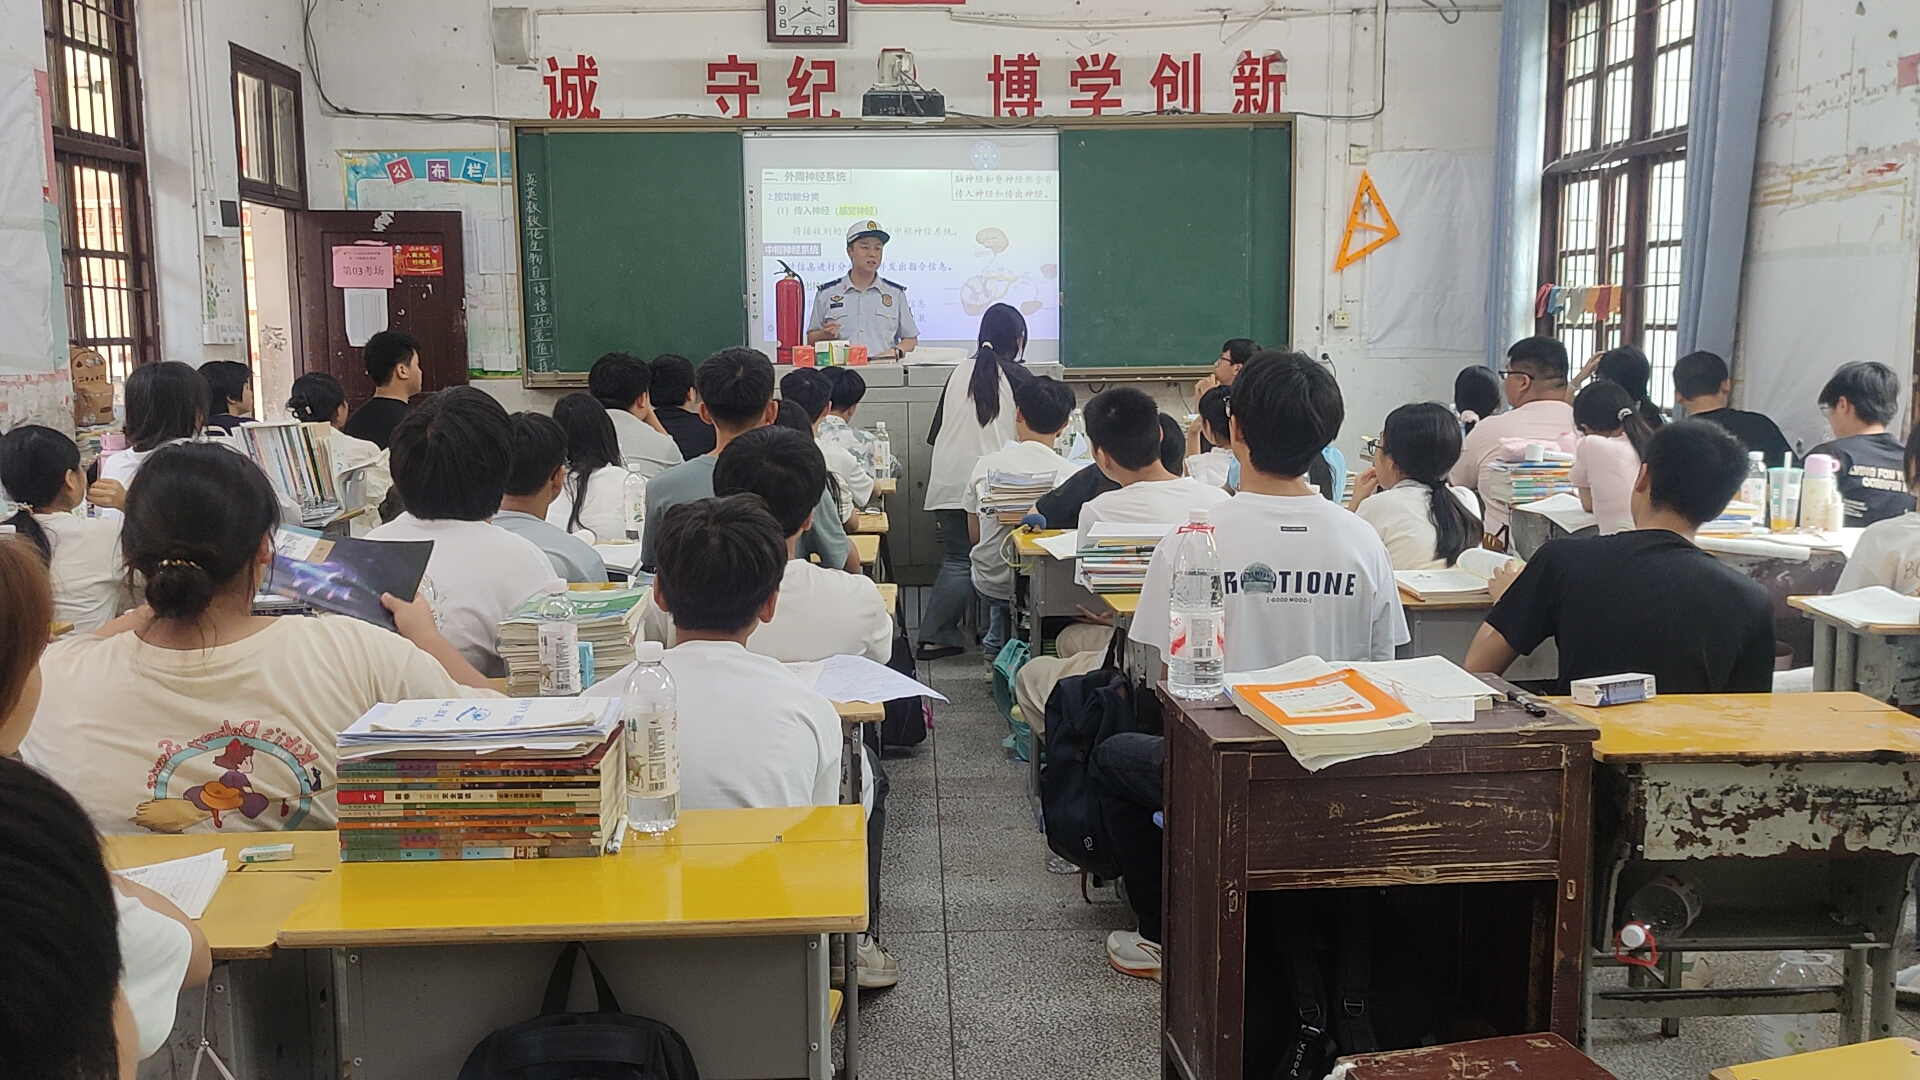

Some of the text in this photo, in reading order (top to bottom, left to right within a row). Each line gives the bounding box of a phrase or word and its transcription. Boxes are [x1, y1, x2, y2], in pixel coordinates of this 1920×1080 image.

[779, 6, 787, 15] 9
[827, 6, 836, 16] 3
[779, 19, 787, 29] 8
[827, 19, 836, 29] 4
[791, 26, 799, 36] 7
[803, 26, 812, 36] 6
[816, 26, 824, 36] 5
[543, 49, 1287, 120] 诚 守纪 博学创新
[391, 162, 484, 181] 公布栏
[764, 171, 847, 182] 二、外周神经系统
[954, 174, 1053, 185] 脑神经和脊神经都含有
[768, 192, 820, 202] 2.按功能分类
[954, 189, 1049, 199] 传入神经和传出神经。
[764, 244, 820, 256] 中枢神经系统
[342, 265, 385, 277] 第03考场
